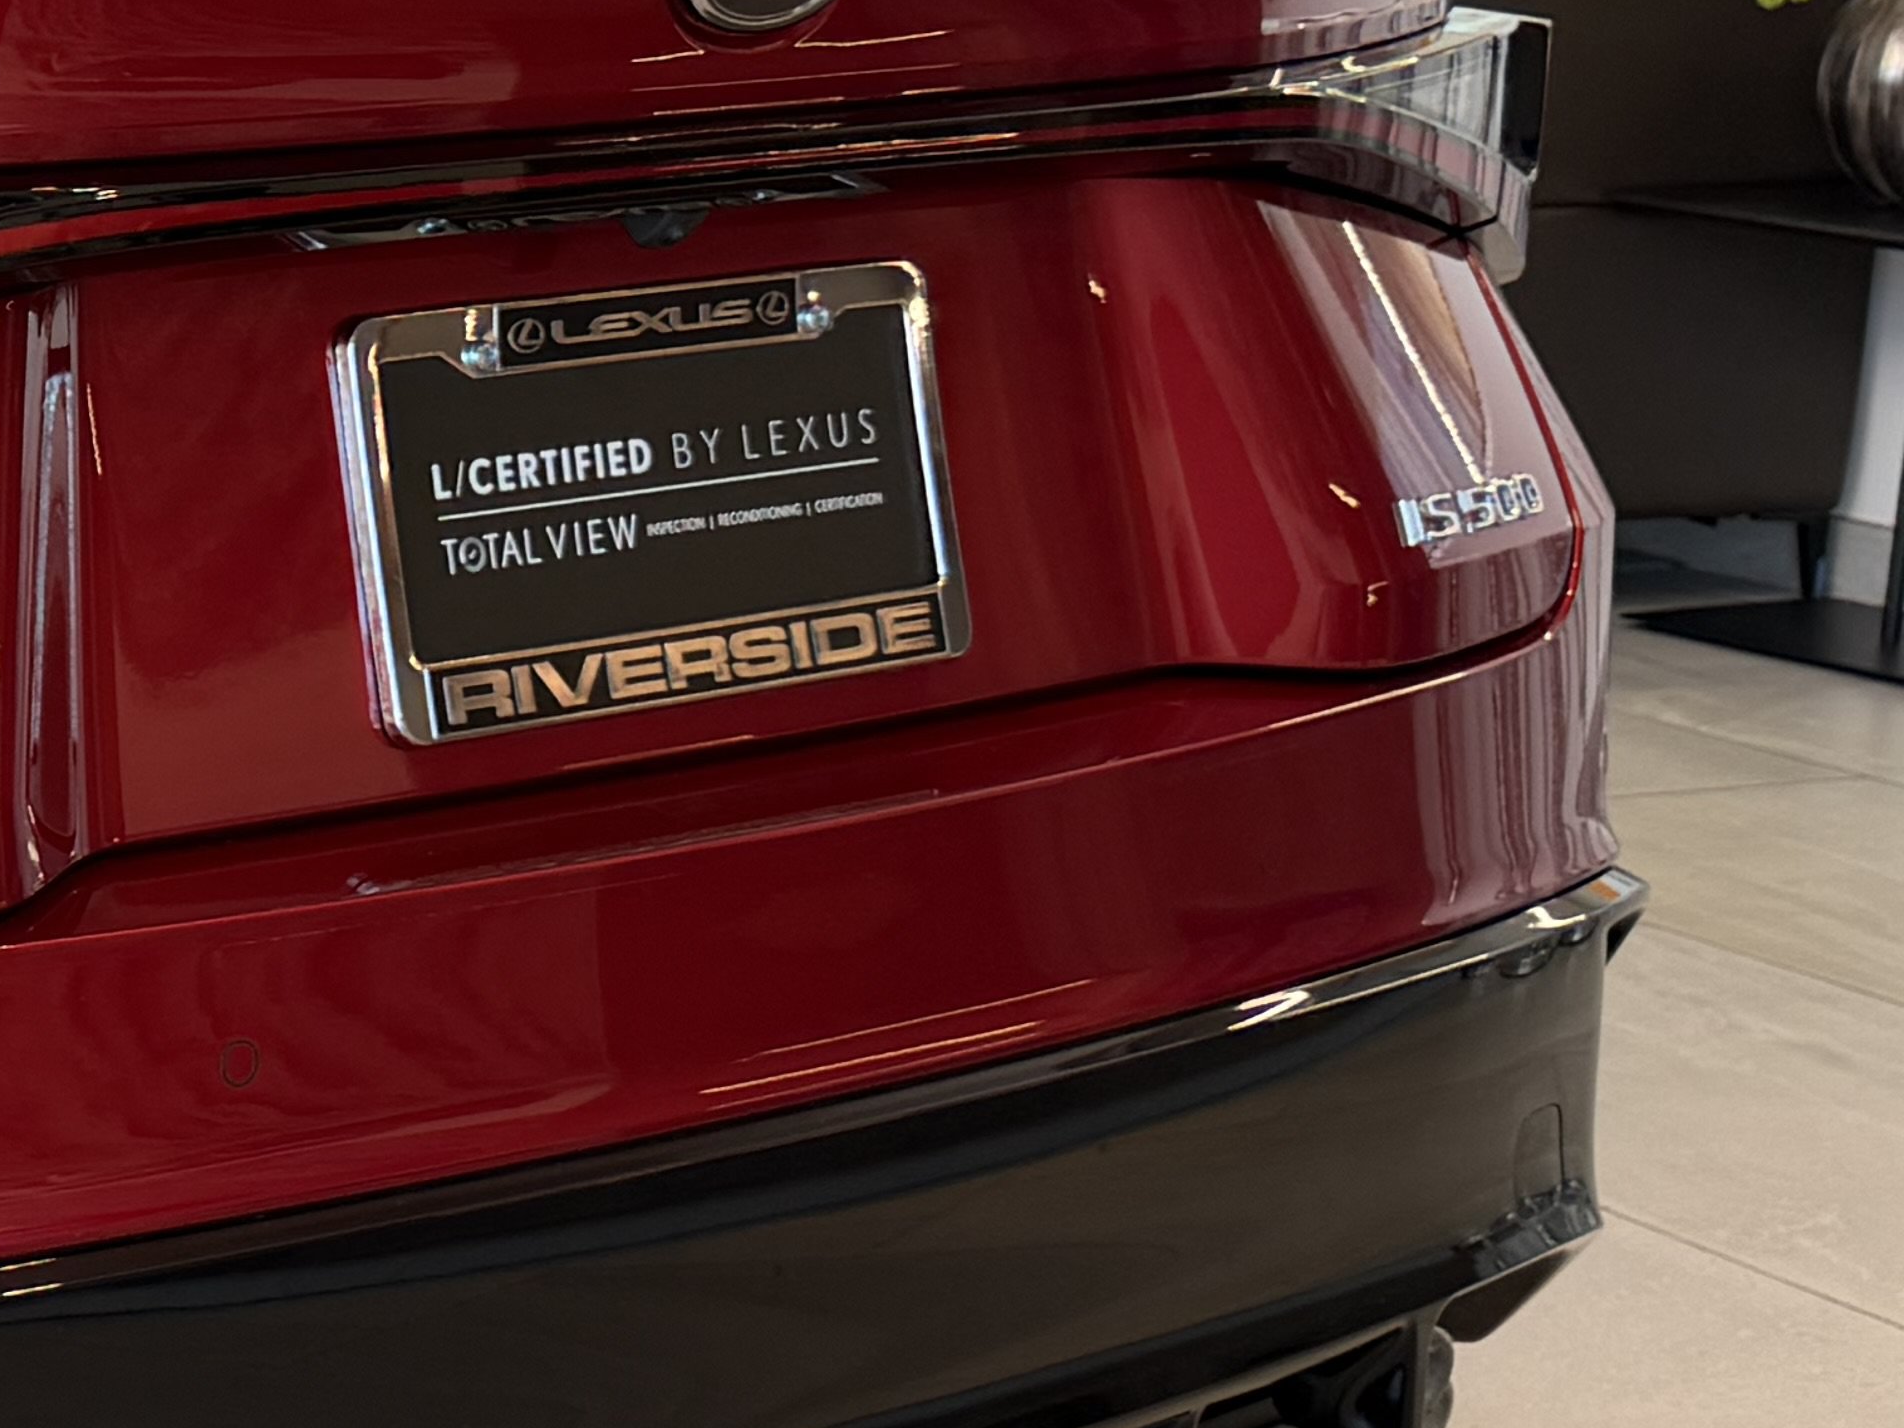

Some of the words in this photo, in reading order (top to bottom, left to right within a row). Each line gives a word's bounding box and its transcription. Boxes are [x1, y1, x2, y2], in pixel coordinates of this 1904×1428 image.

[550, 298, 755, 345] LEXUS
[671, 428, 721, 469] BY
[741, 408, 877, 460] LEXUS
[545, 513, 638, 560] VIEW
[645, 515, 707, 537] INSPECTION
[717, 502, 803, 527] RECONDITIONING
[813, 491, 884, 514] CERTIFICATION
[441, 600, 937, 727] RIVERSIDE
